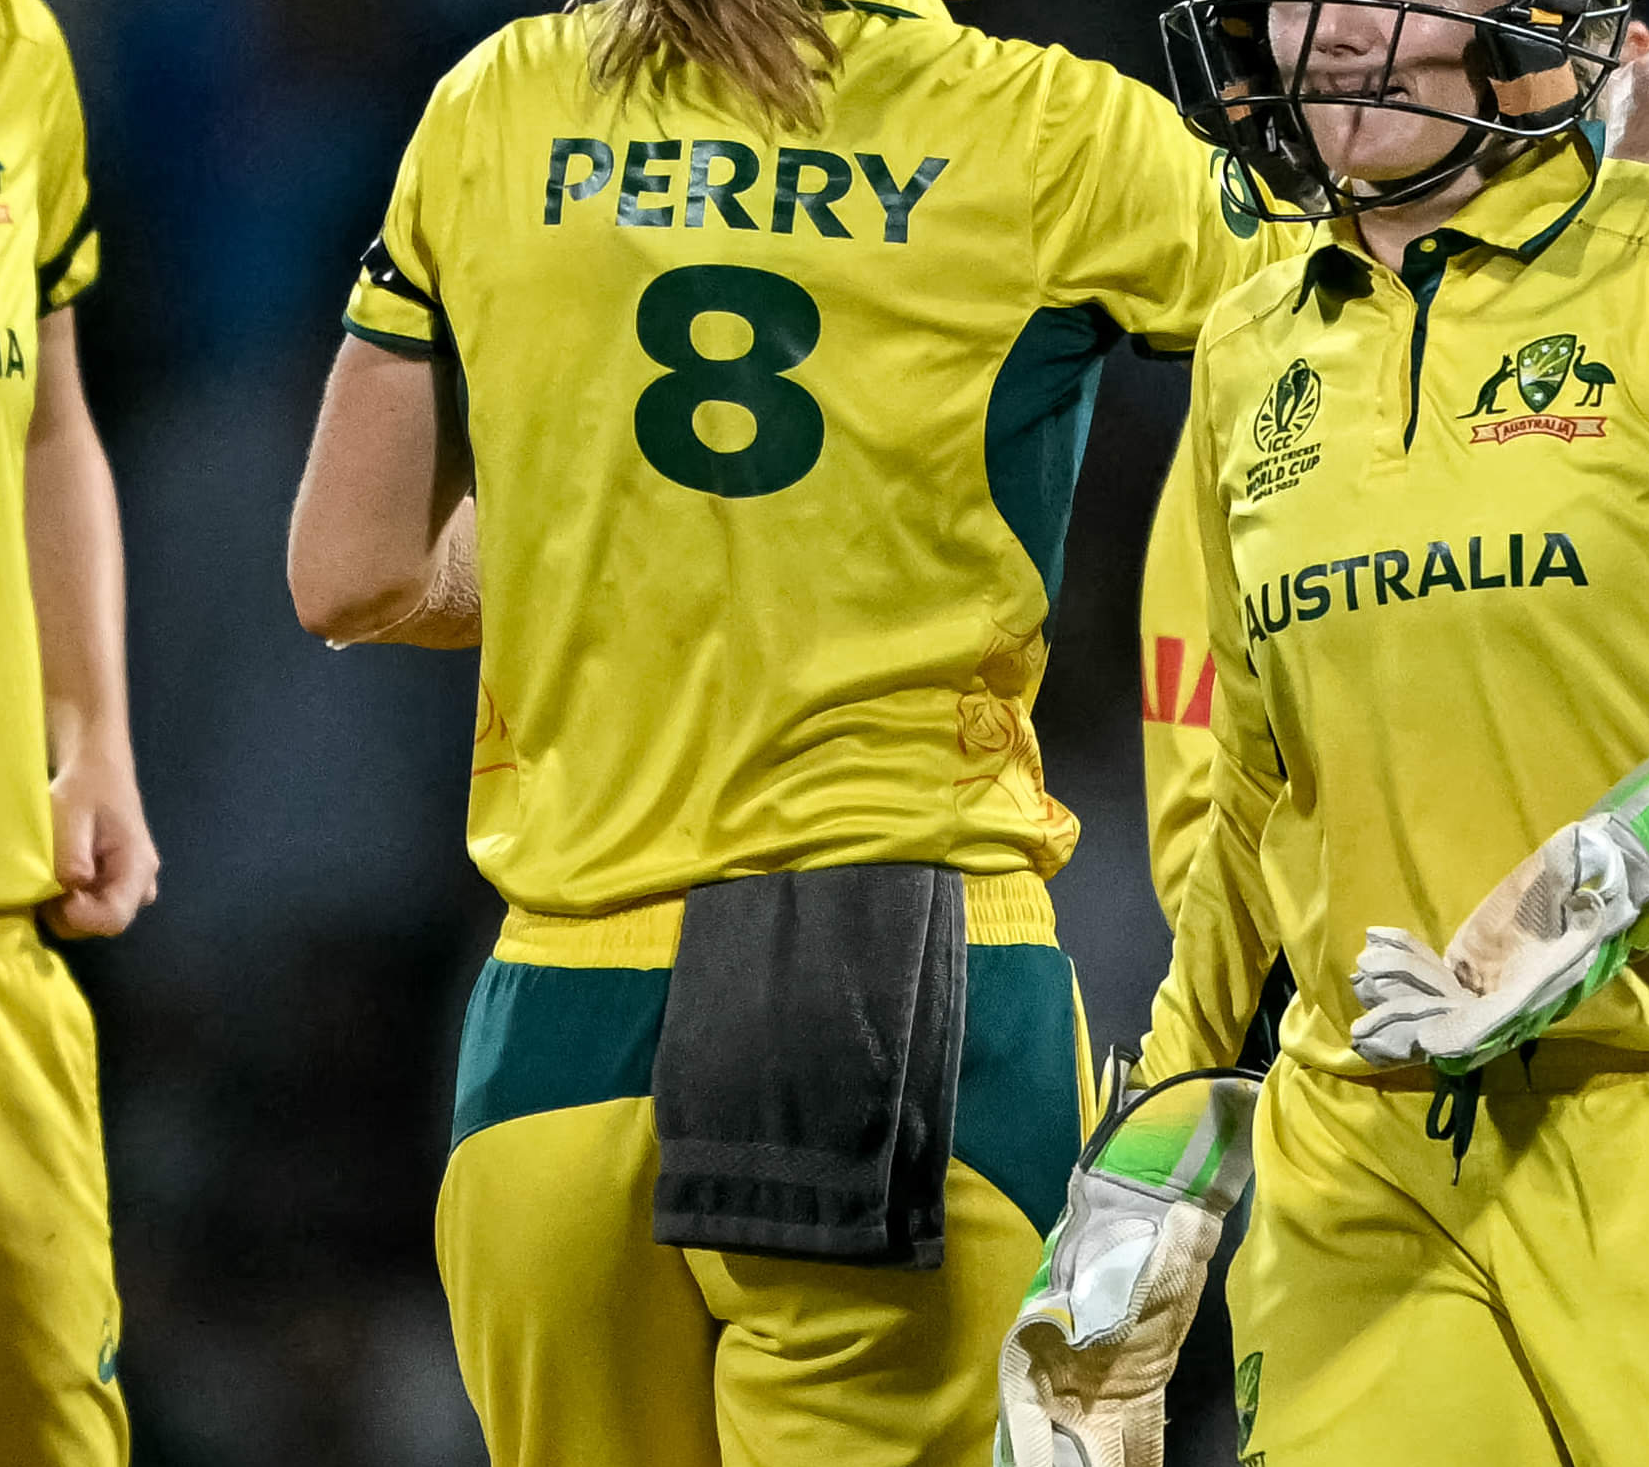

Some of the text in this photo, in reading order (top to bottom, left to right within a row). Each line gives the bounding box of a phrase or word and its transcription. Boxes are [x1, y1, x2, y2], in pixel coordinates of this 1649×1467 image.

[544, 137, 950, 244] PERRY
[634, 264, 825, 498] 8
[1268, 434, 1293, 453] ICC
[1502, 418, 1570, 436] AUSTRALIA
[1288, 455, 1320, 476] CUP
[1244, 532, 1589, 678] AUSTRALIA
